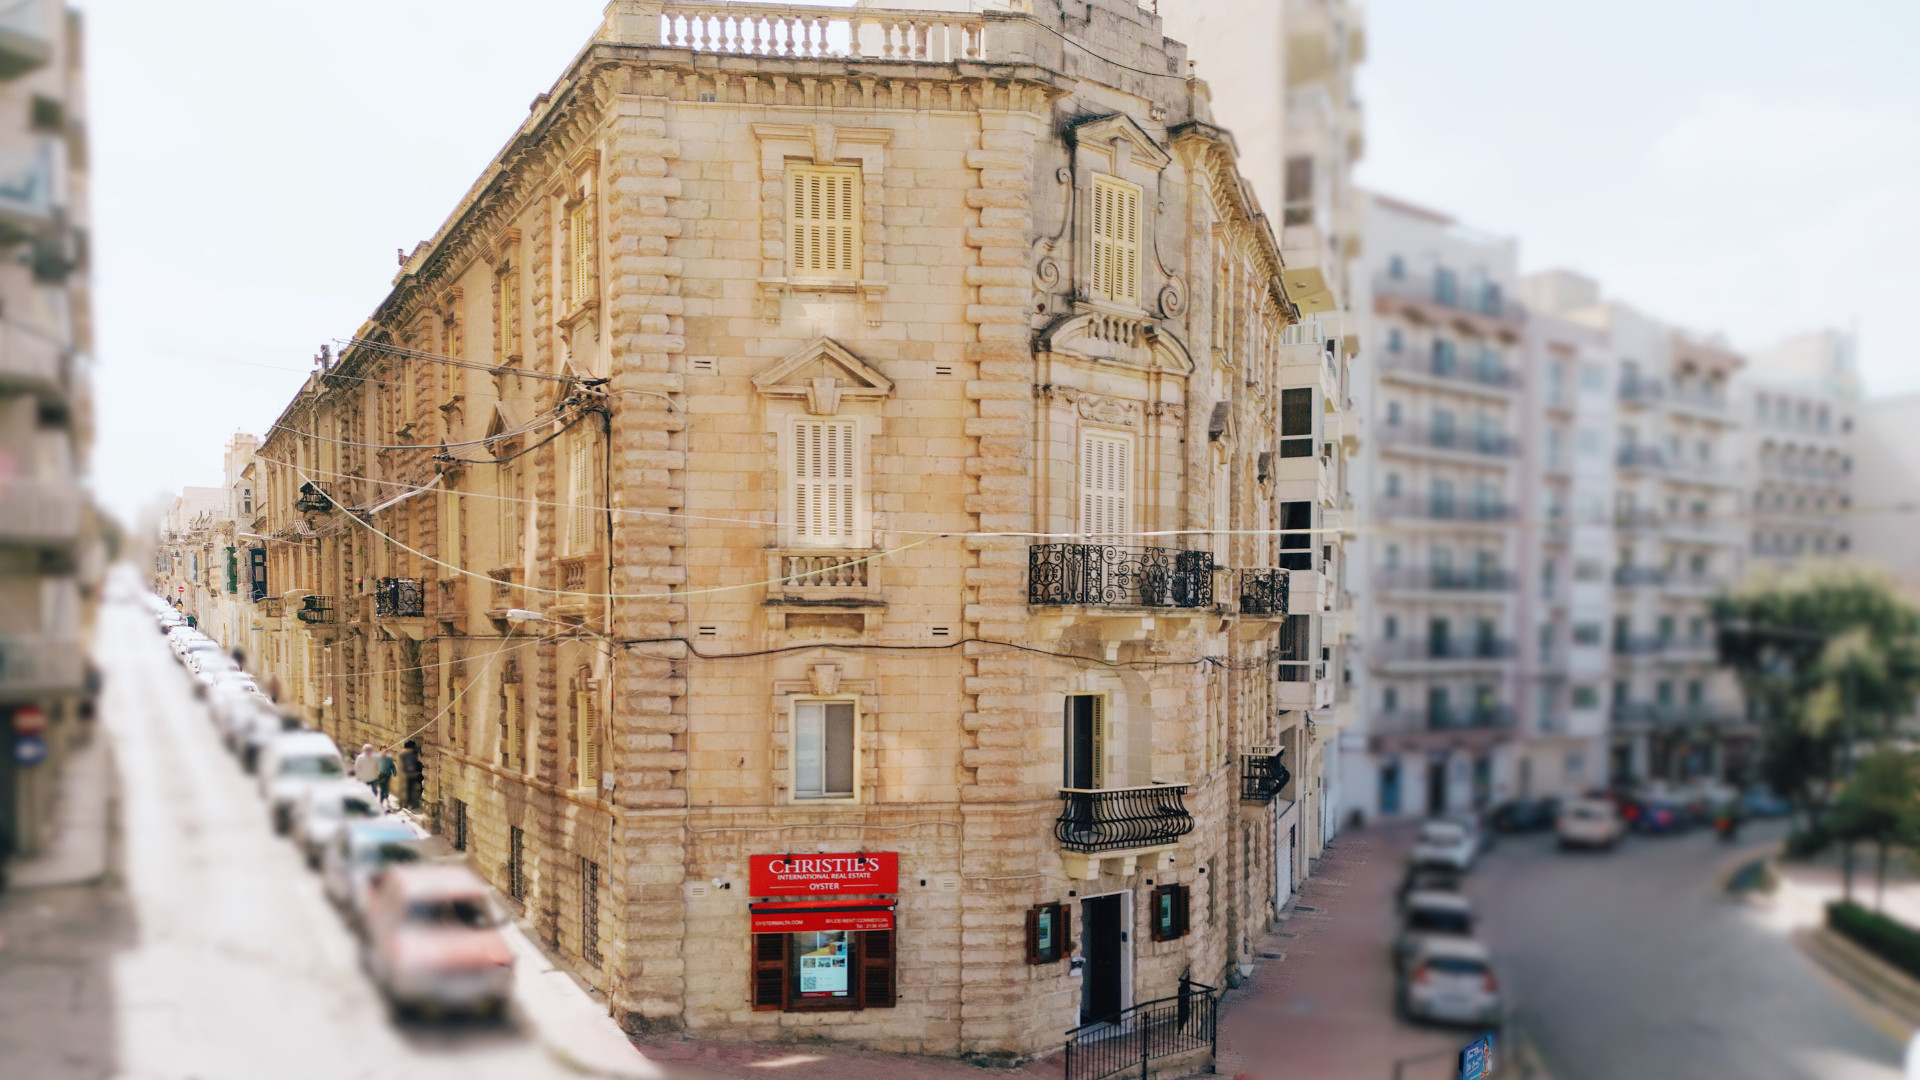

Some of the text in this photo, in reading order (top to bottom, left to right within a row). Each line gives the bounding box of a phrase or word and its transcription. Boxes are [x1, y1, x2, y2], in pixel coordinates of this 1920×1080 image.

[768, 858, 879, 874] CHRISTIE'S
[777, 873, 830, 881] INTERNATIONAL
[809, 883, 840, 891] OYSTER
